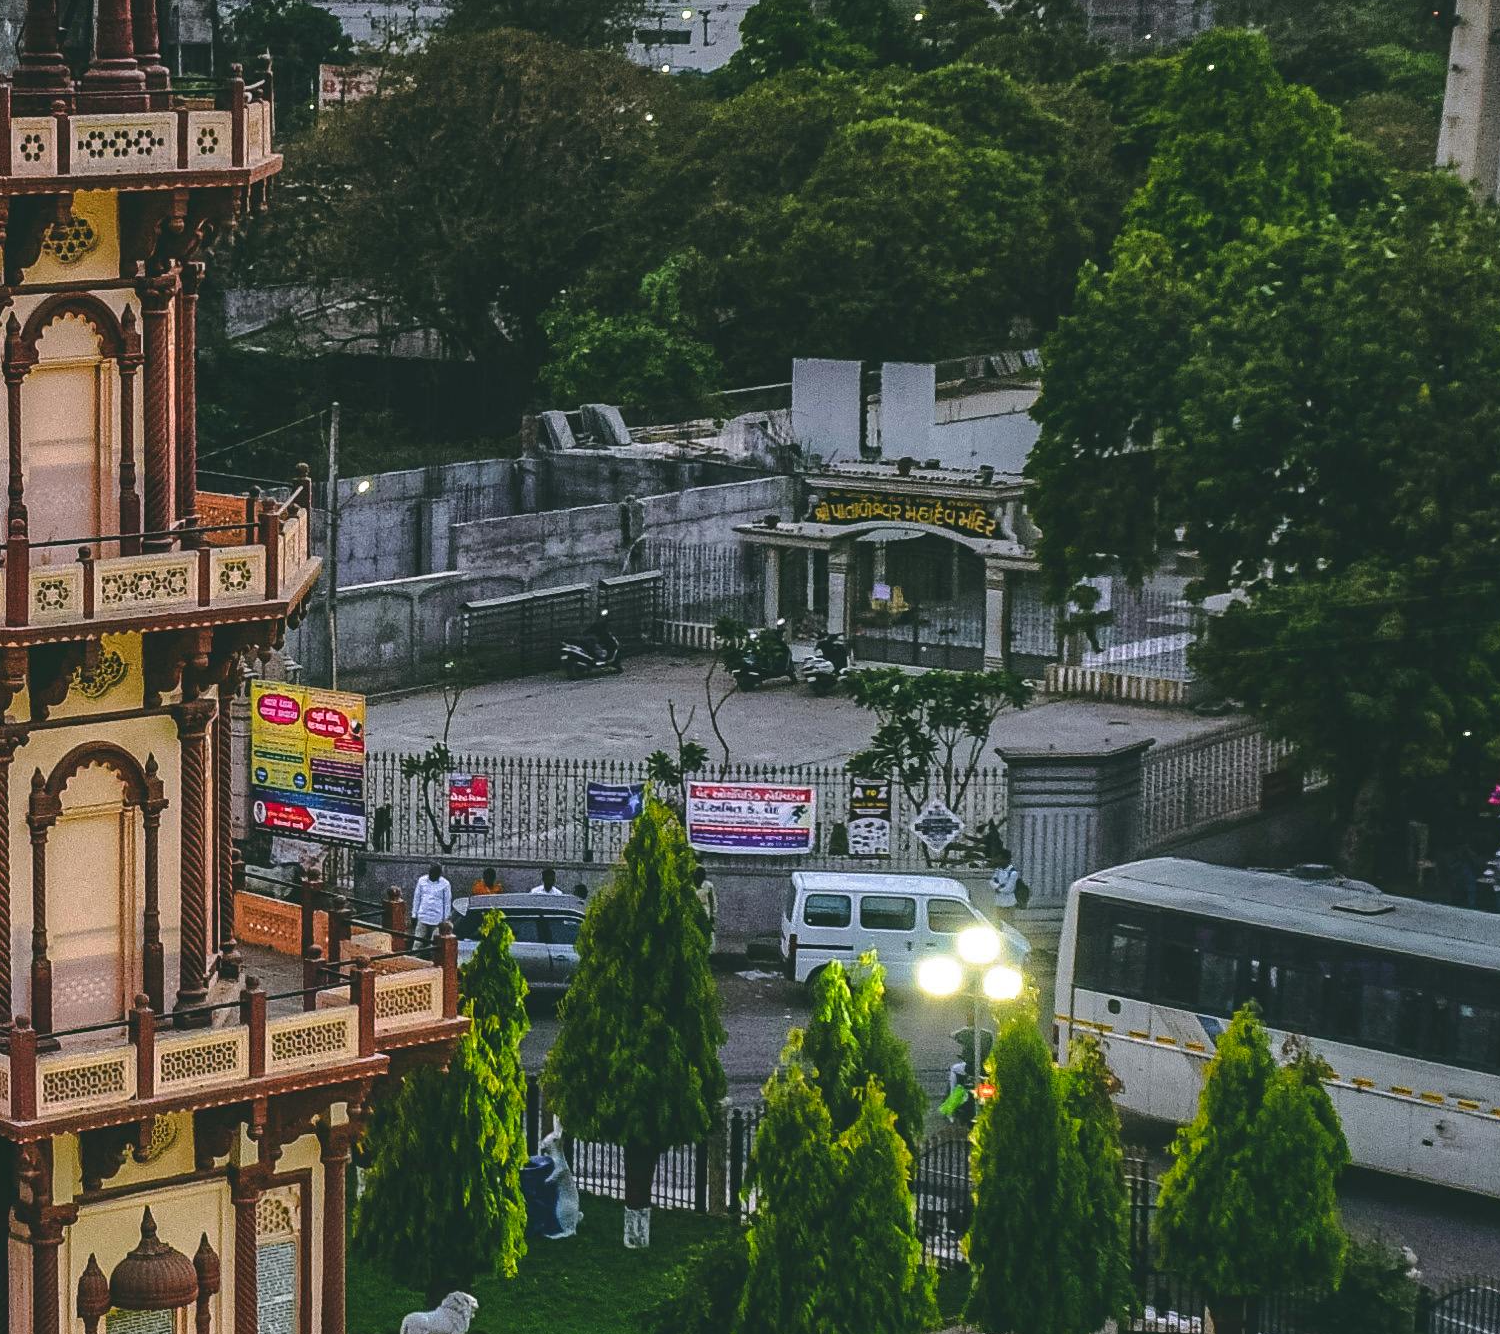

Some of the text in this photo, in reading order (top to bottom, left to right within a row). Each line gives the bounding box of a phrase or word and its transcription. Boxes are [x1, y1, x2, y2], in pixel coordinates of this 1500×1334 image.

[905, 500, 955, 525] મહાદેવ
[958, 508, 997, 537] મંદિર
[852, 786, 864, 799] A
